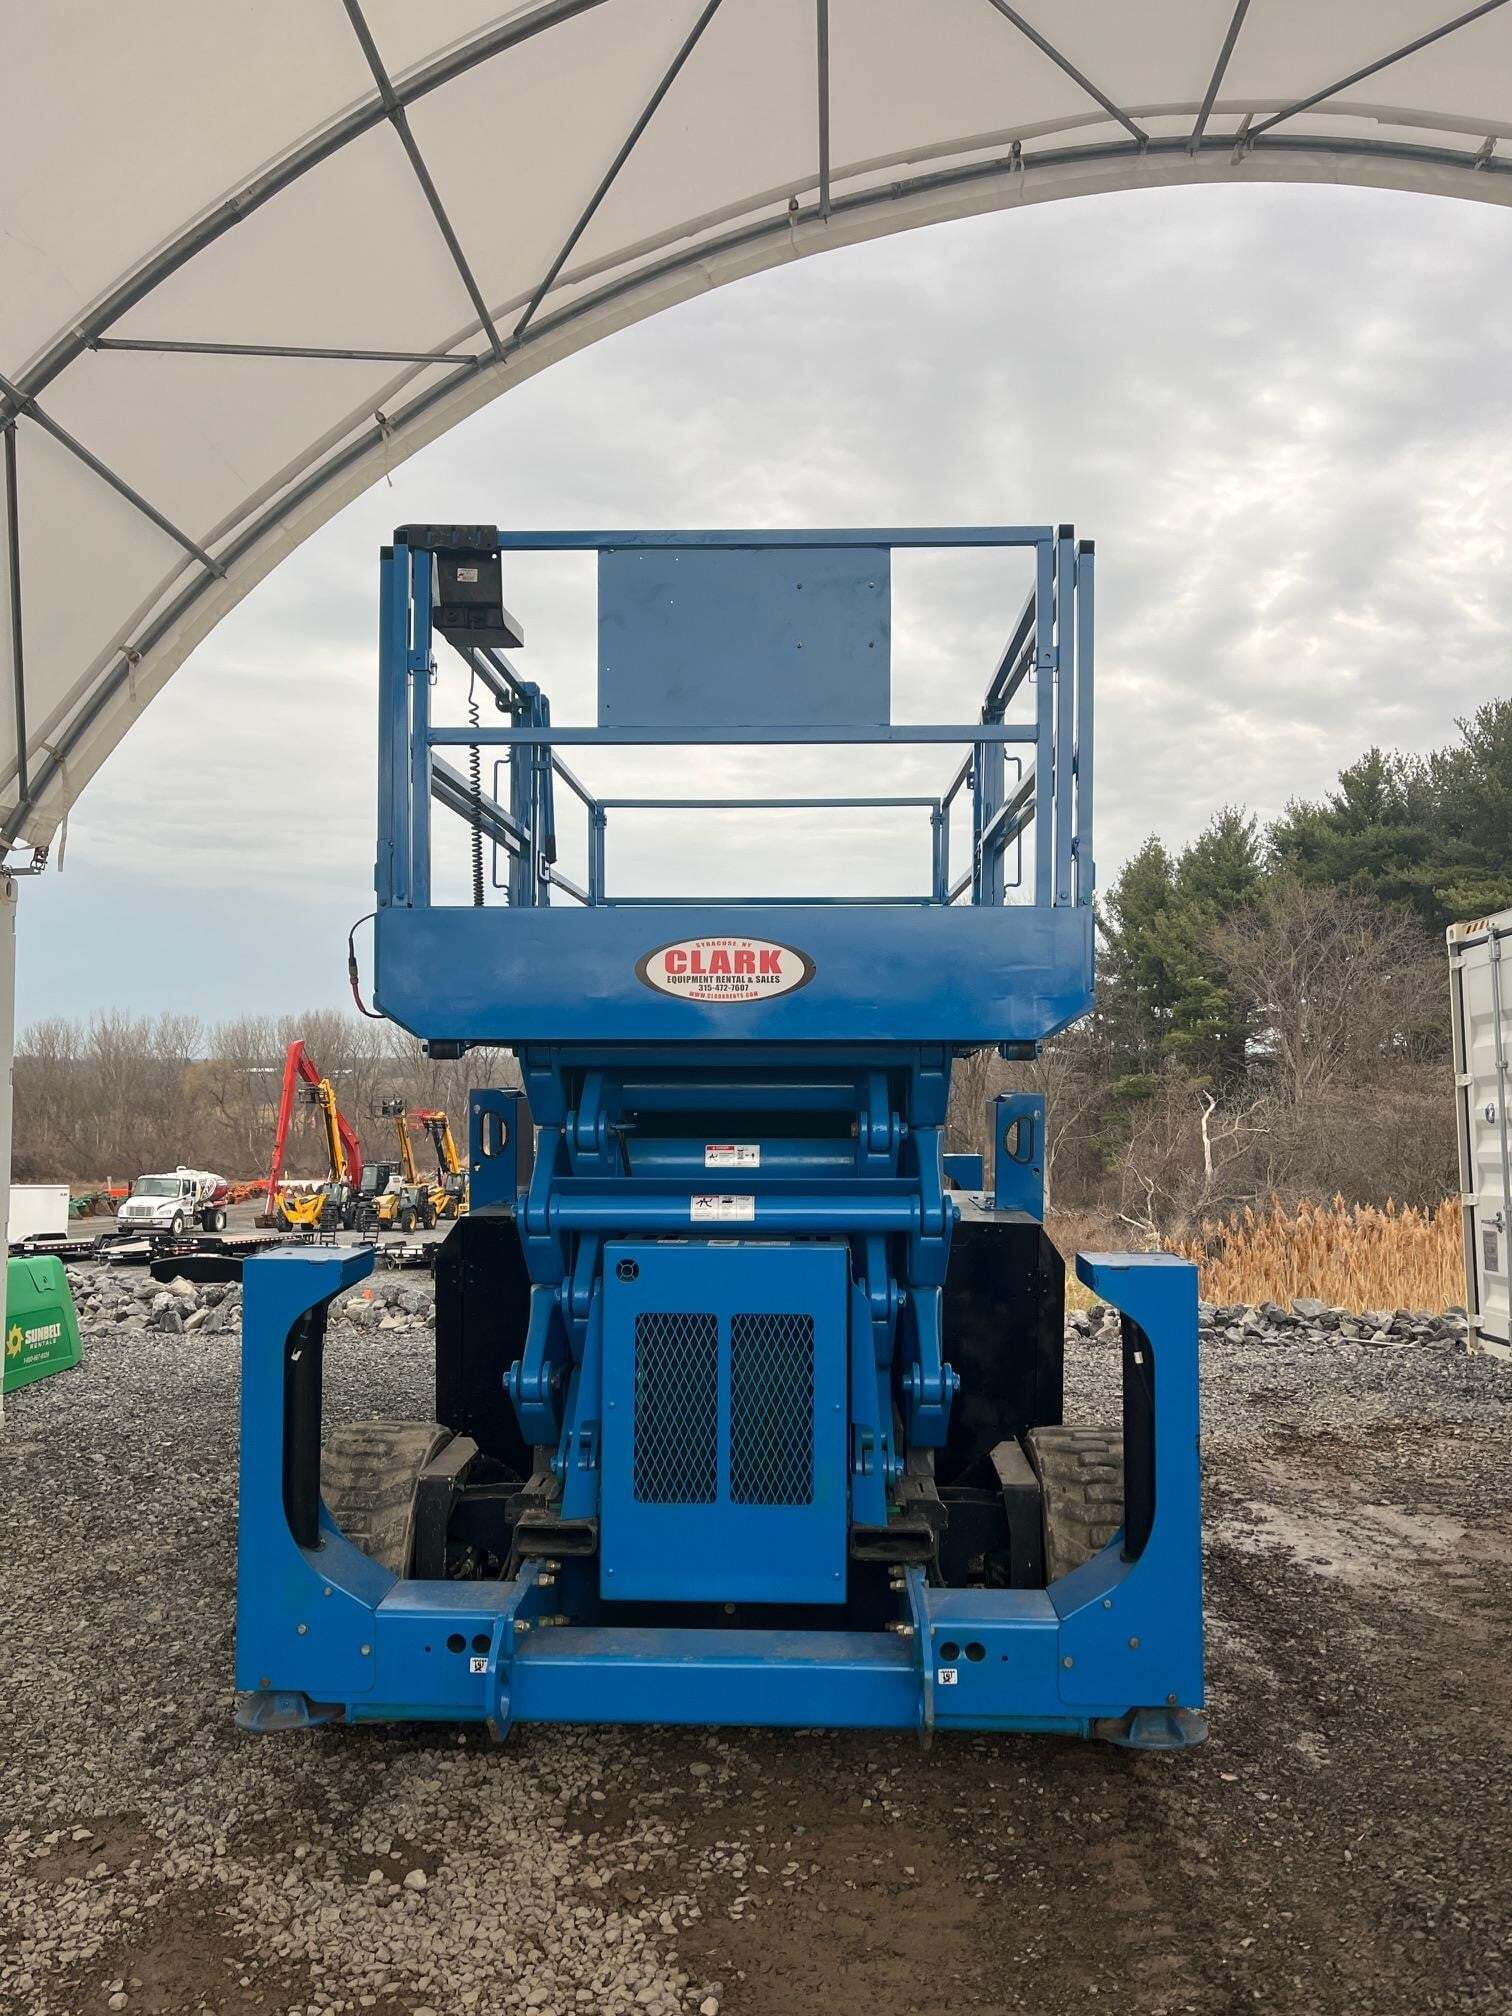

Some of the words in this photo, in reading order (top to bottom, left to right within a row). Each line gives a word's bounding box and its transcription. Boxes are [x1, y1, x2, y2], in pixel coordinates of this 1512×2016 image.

[664, 950, 782, 975] CLARK
[667, 975, 713, 984] EQUIPMENT
[715, 975, 746, 984] RENTAL
[747, 976, 753, 984] &
[755, 975, 780, 984] SALES
[698, 984, 749, 992] 315-472-7607
[25, 1323, 61, 1345] SUNBELT
[29, 1338, 57, 1349] RENTALS
